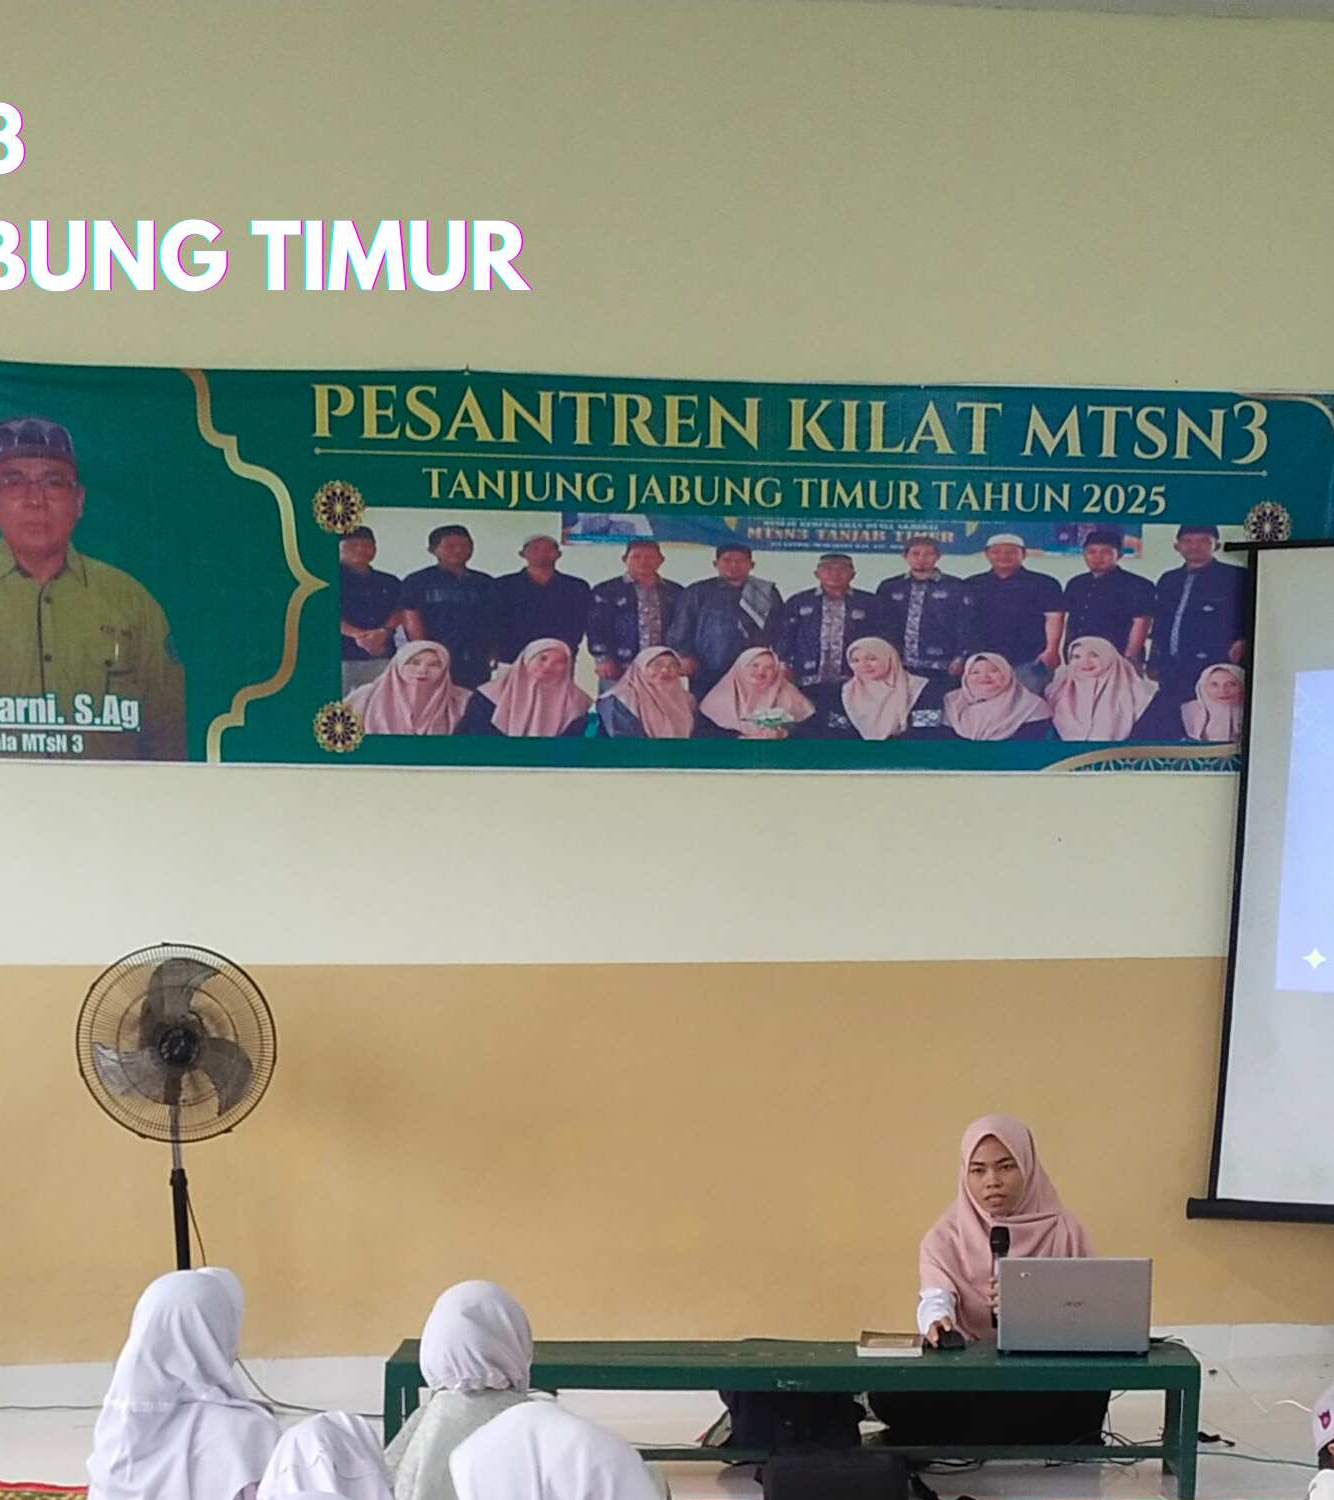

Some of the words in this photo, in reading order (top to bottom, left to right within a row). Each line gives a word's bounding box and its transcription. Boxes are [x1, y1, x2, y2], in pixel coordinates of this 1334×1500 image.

[310, 384, 763, 451] PESANTREN
[787, 398, 1003, 455] KILAT
[1019, 400, 1269, 465] MTSN3
[421, 466, 616, 508] TANJUNG
[623, 473, 783, 512] JABUNG
[793, 477, 923, 511] TIMUR
[931, 480, 1072, 513] TAHUN
[1081, 483, 1167, 516] 2025
[21, 733, 68, 752] MTsN
[71, 733, 84, 753] 3
